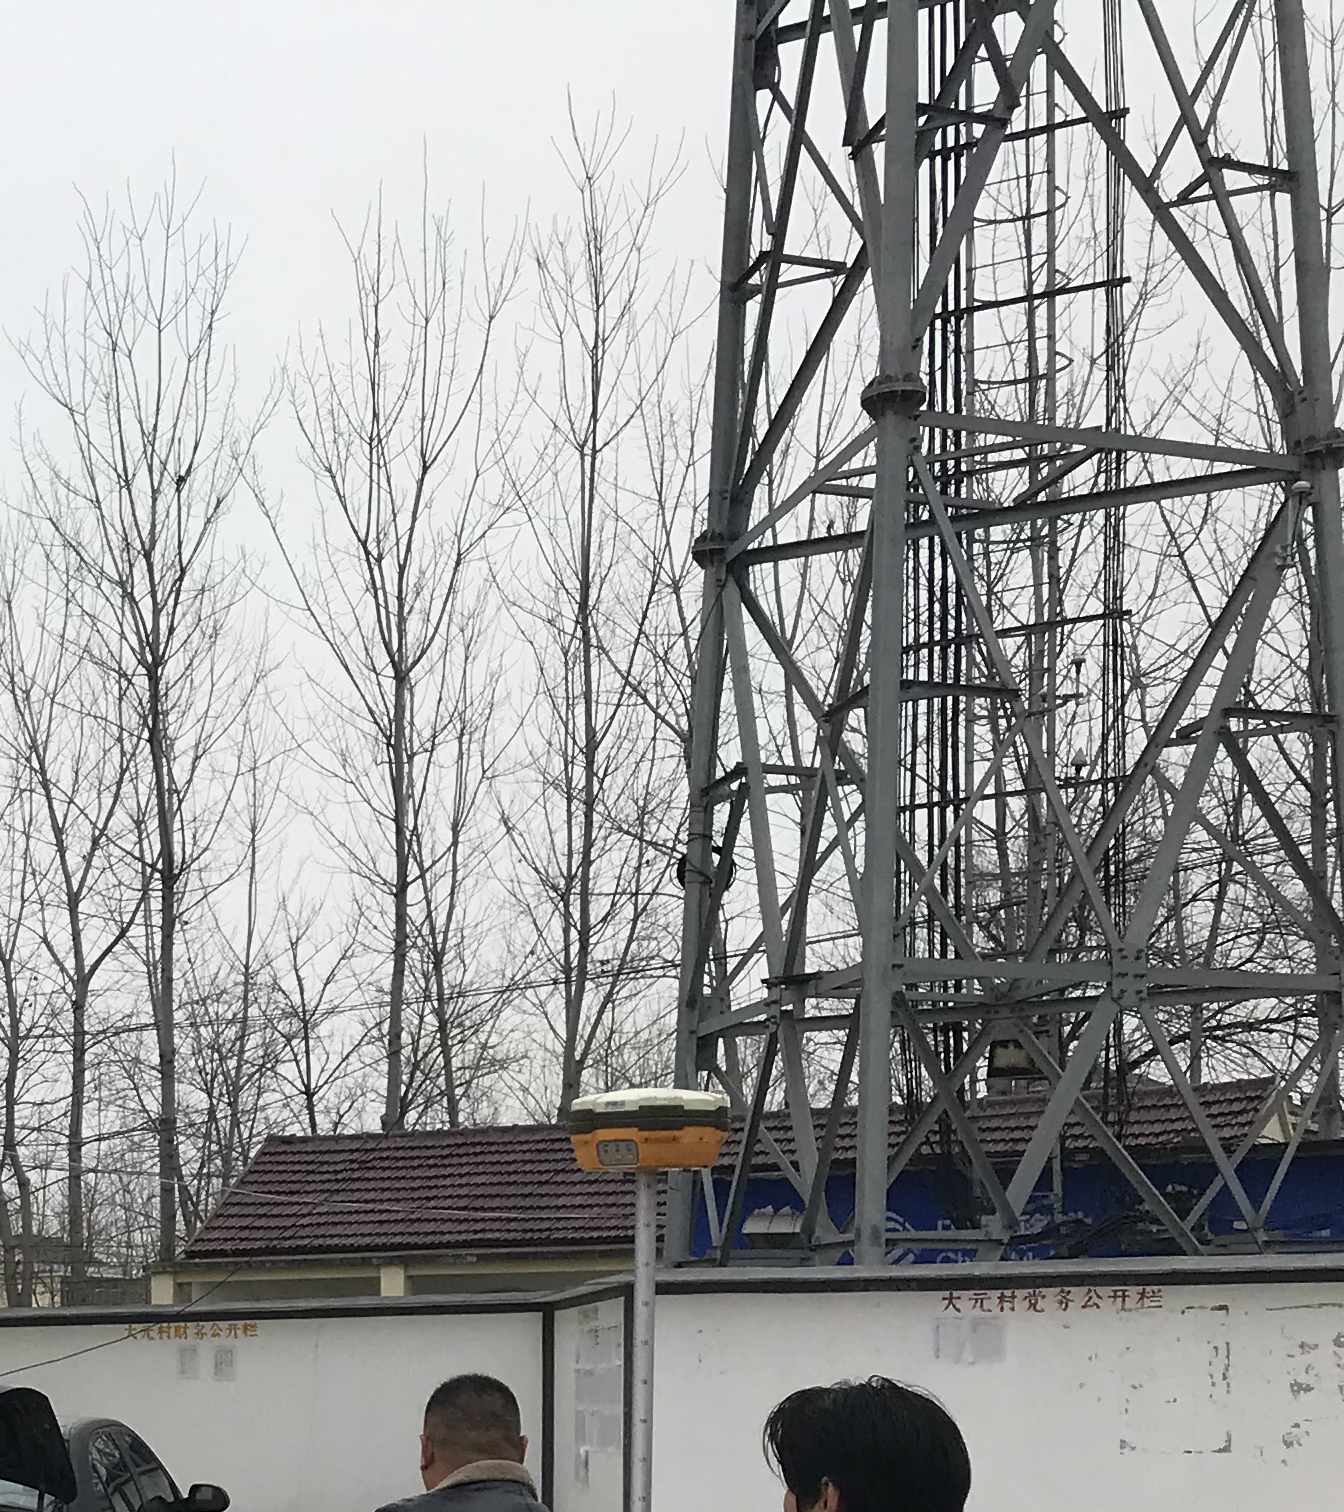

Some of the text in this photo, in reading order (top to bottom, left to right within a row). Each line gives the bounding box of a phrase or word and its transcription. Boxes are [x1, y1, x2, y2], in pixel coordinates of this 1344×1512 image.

[941, 1287, 1164, 1313] 大元村党务公开栏
[124, 1322, 259, 1340] 大元村财务公开栏
